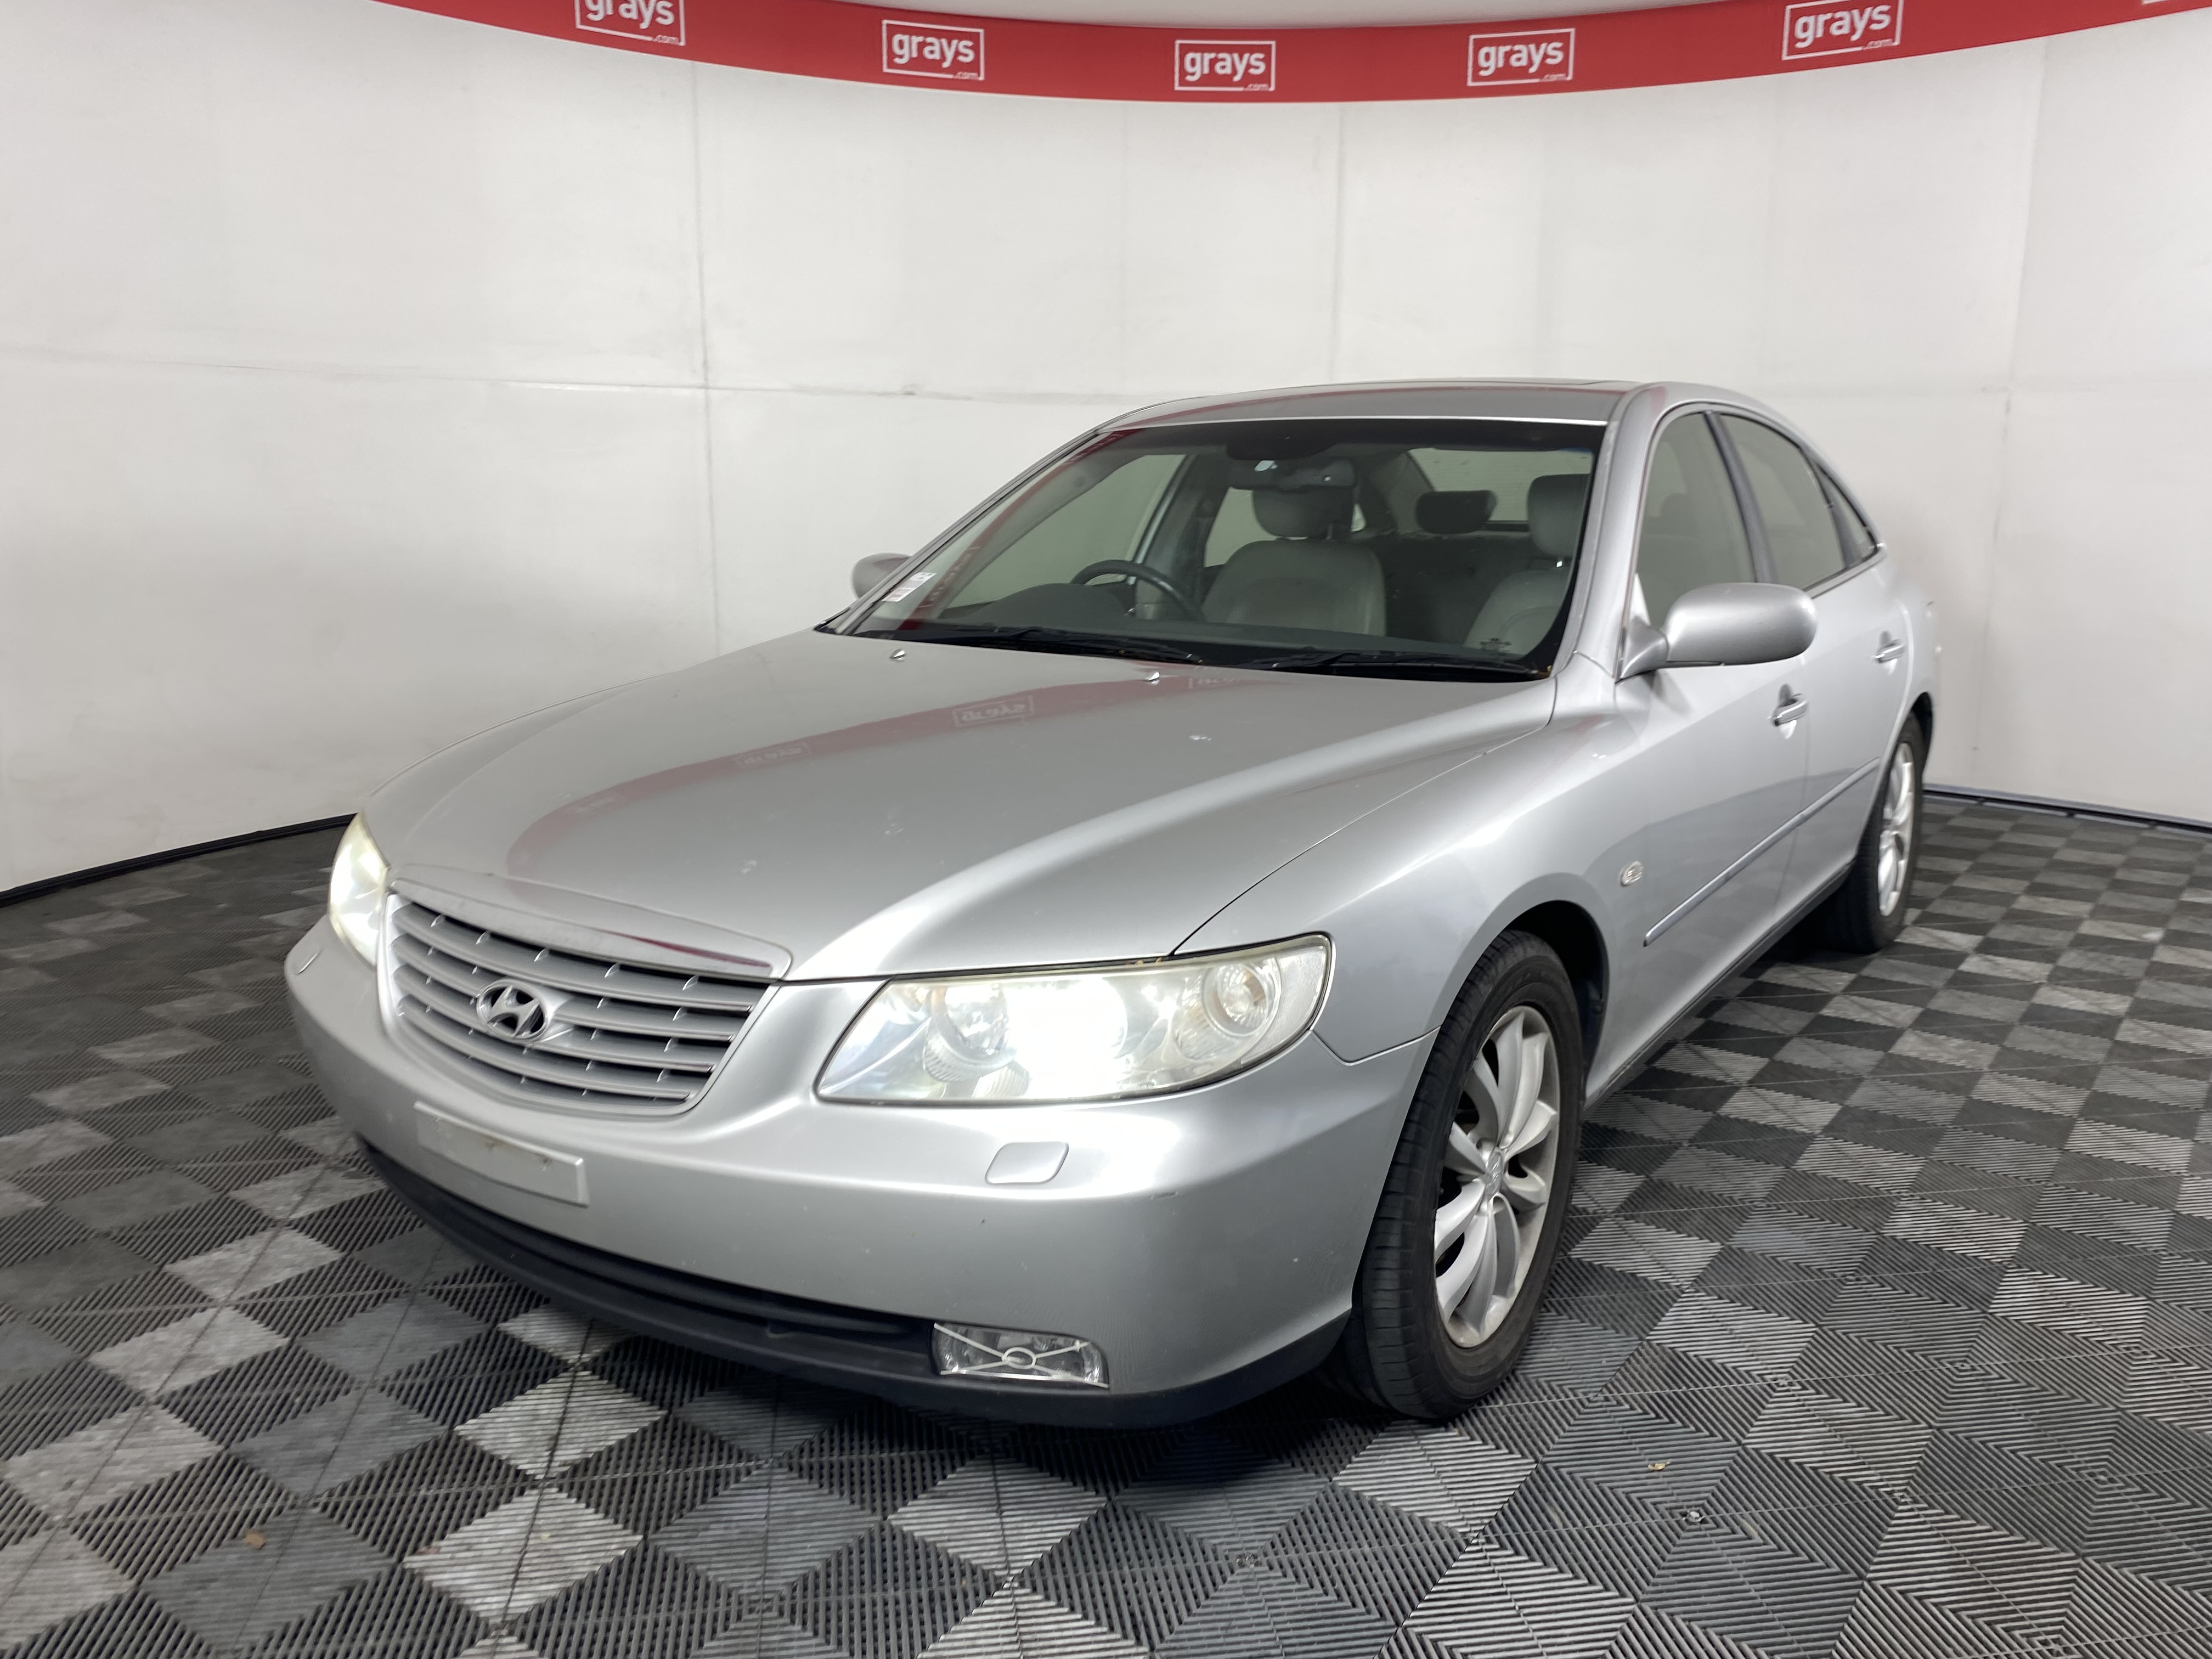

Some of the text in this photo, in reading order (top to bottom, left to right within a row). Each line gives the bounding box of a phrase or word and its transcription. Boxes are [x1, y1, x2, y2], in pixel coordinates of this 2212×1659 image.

[1795, 4, 1891, 48] grays
[892, 33, 975, 68] grays
[1184, 52, 1266, 82] grays
[1477, 42, 1564, 76] grays
